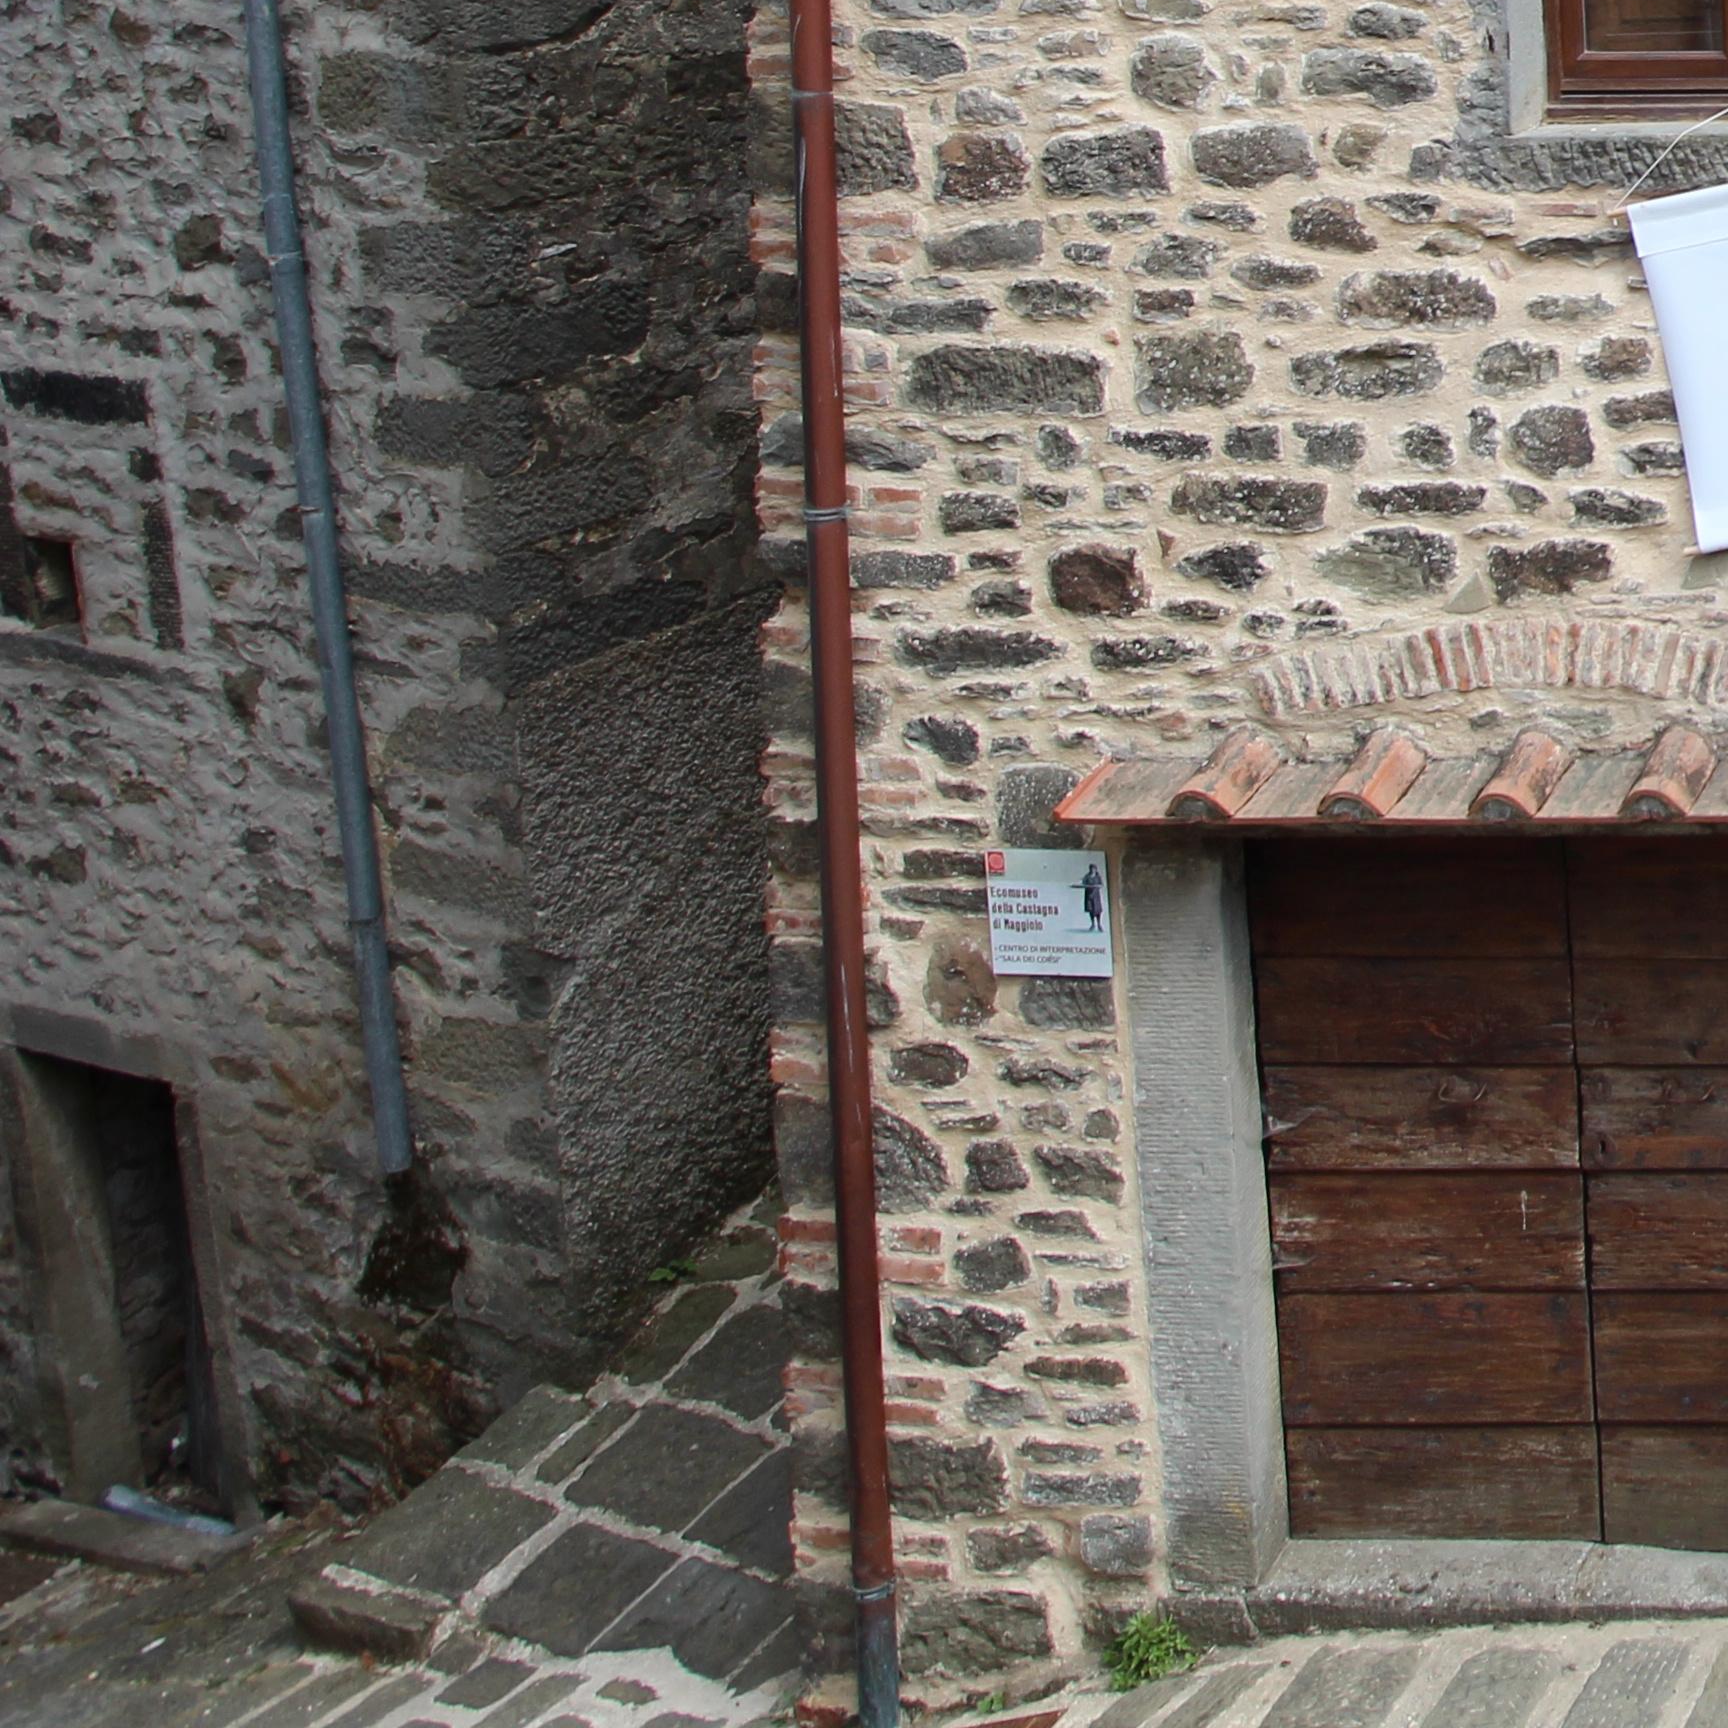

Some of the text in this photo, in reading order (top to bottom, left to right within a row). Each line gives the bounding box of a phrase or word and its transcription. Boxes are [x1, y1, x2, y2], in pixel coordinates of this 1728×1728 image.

[990, 886, 1038, 899] Ecomuseo
[992, 903, 1059, 917] della Castagna
[993, 918, 1043, 933] di Raggiolo
[998, 944, 1106, 954] CENTRO DI INTERPRETAZIONE
[1023, 955, 1035, 963] DEI
